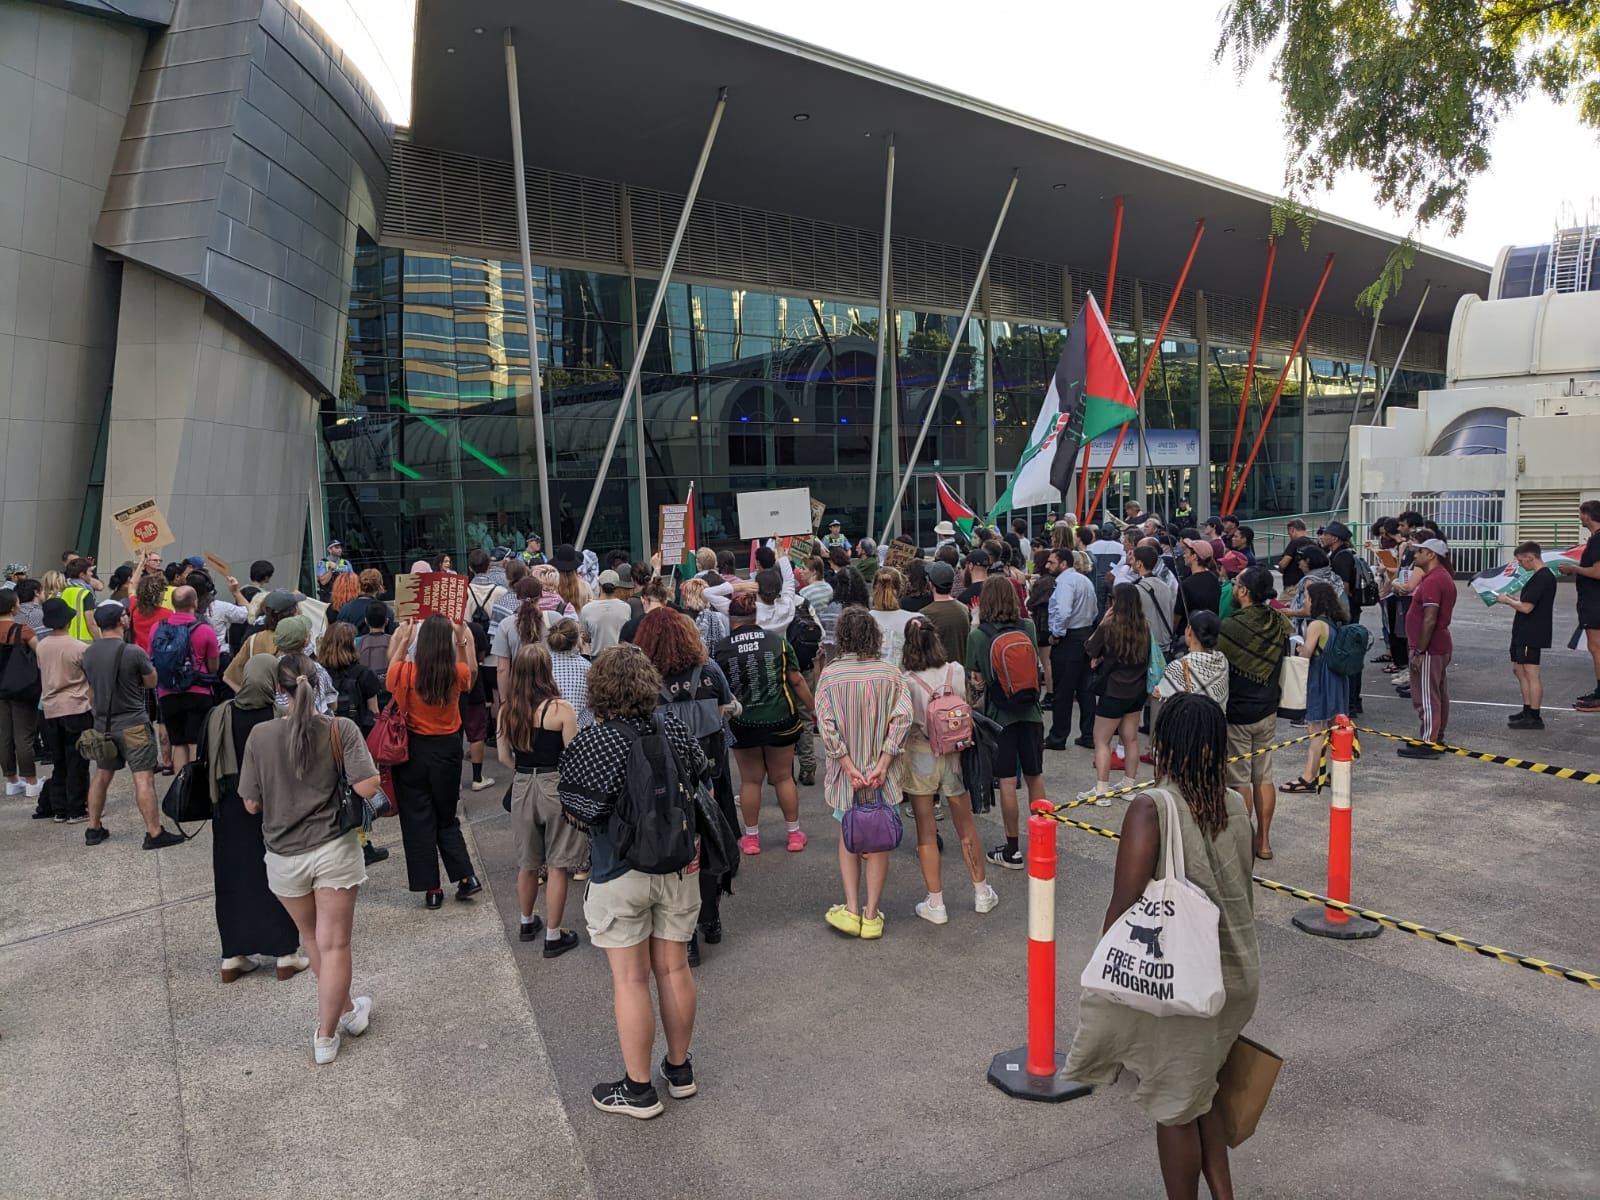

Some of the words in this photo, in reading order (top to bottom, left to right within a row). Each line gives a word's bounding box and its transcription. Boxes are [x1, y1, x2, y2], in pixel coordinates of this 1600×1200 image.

[432, 581, 440, 612] DRINKABLE
[455, 603, 463, 621] MORE
[730, 631, 765, 644] LEAVERS
[738, 641, 759, 653] 2023
[1106, 947, 1136, 971] FREE
[1139, 960, 1174, 979] FOOD
[1102, 964, 1174, 1000] PROGRAM
